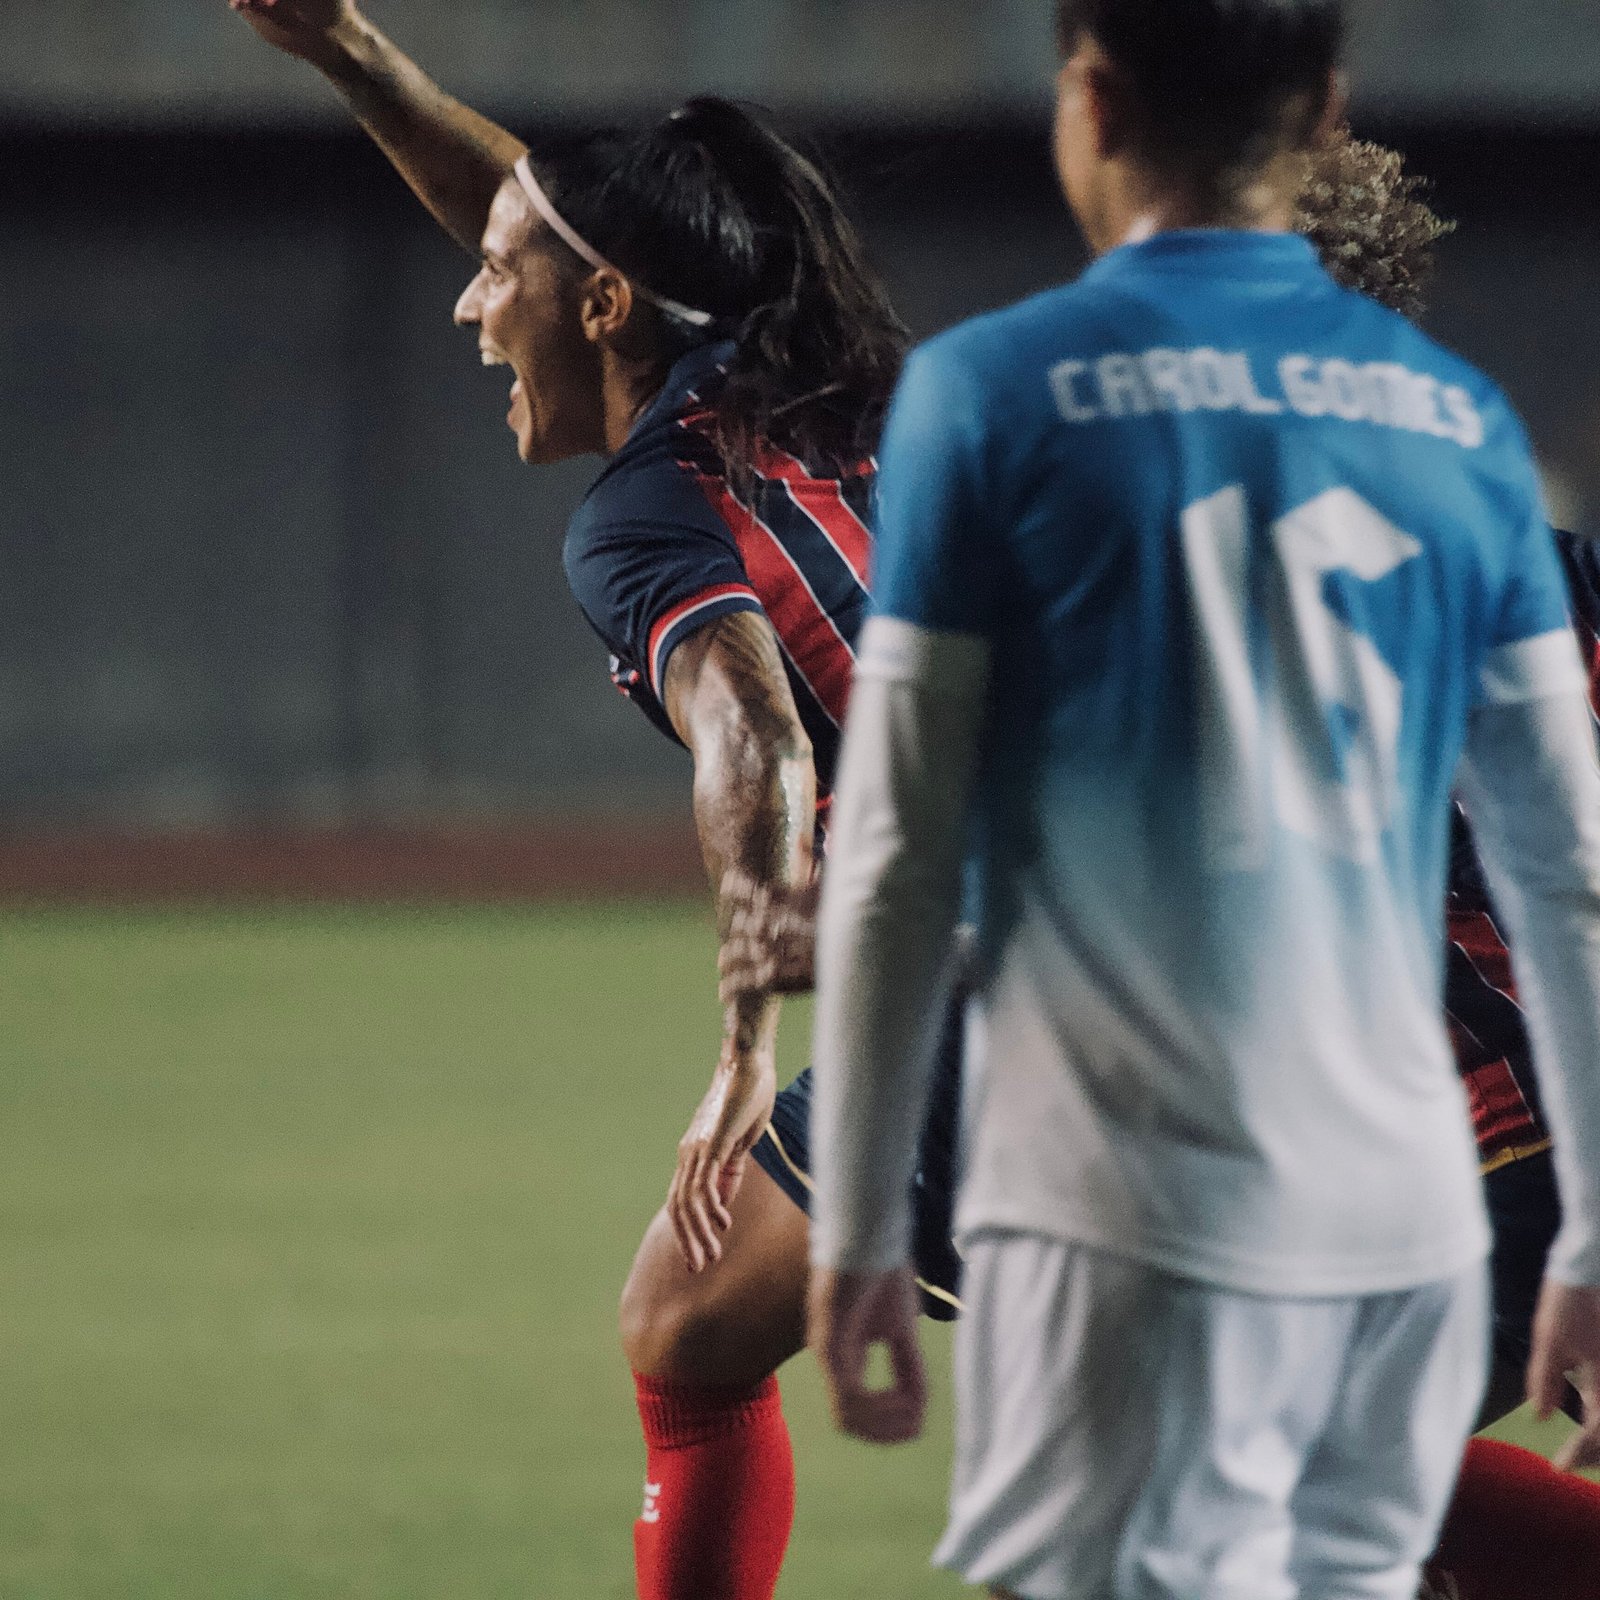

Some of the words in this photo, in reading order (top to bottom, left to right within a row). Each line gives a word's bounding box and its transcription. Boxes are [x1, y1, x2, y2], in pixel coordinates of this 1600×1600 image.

[1048, 347, 1281, 423] CAROL
[1278, 353, 1483, 448] GOMES
[1180, 483, 1424, 872] 16
